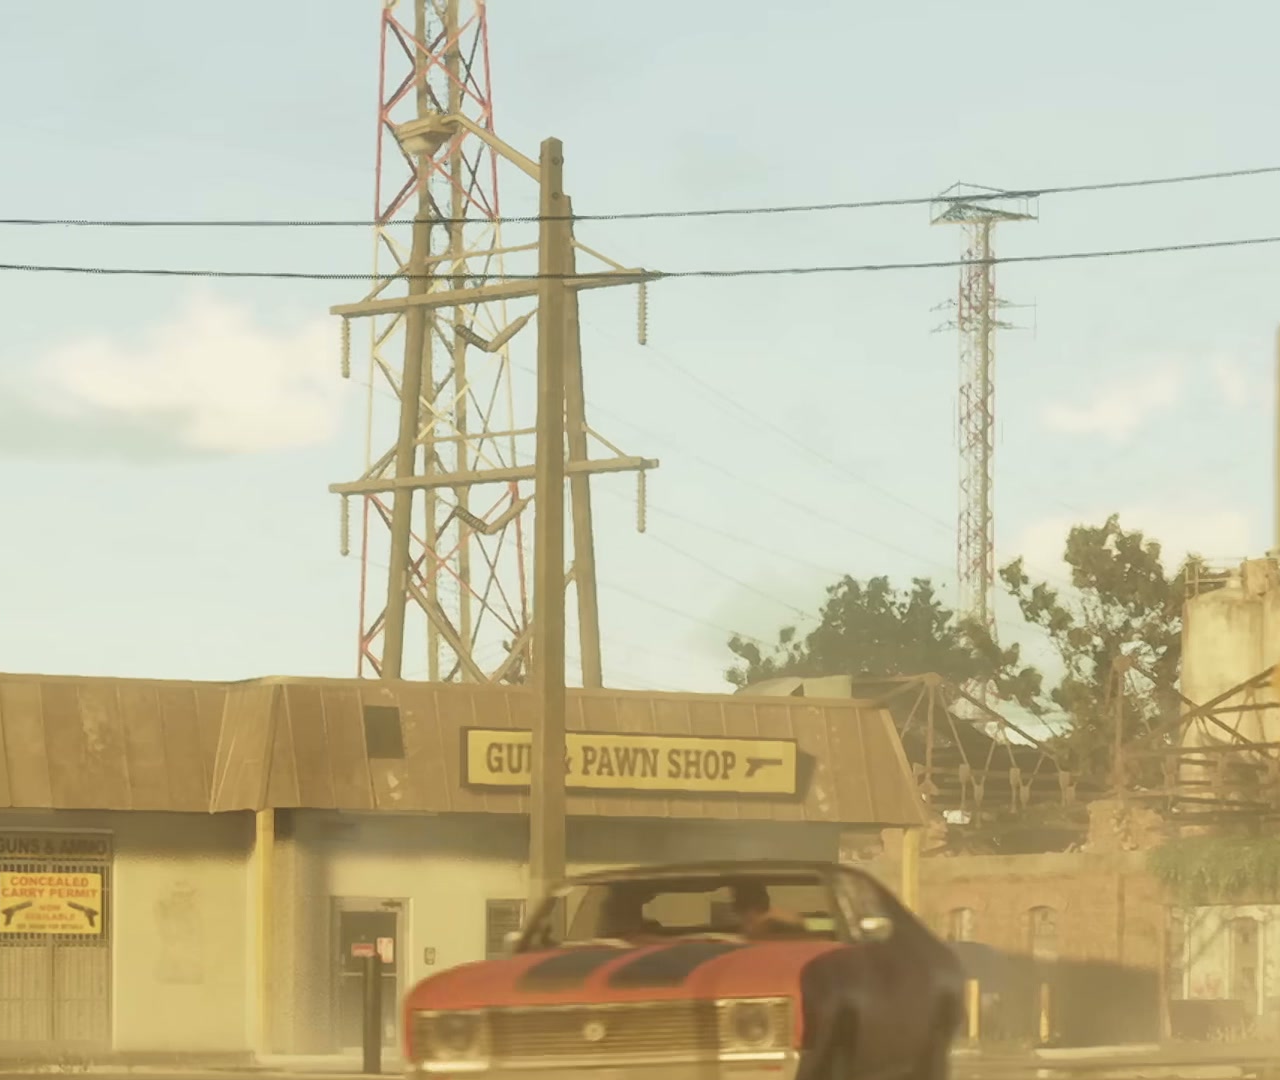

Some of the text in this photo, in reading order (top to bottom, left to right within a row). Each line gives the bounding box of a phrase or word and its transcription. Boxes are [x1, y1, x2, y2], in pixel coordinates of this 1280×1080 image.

[581, 744, 659, 779] PAWN
[667, 747, 737, 781] SHOP
[10, 875, 90, 887] CONCEALED
[1, 887, 98, 898] CARRY PERMIT
